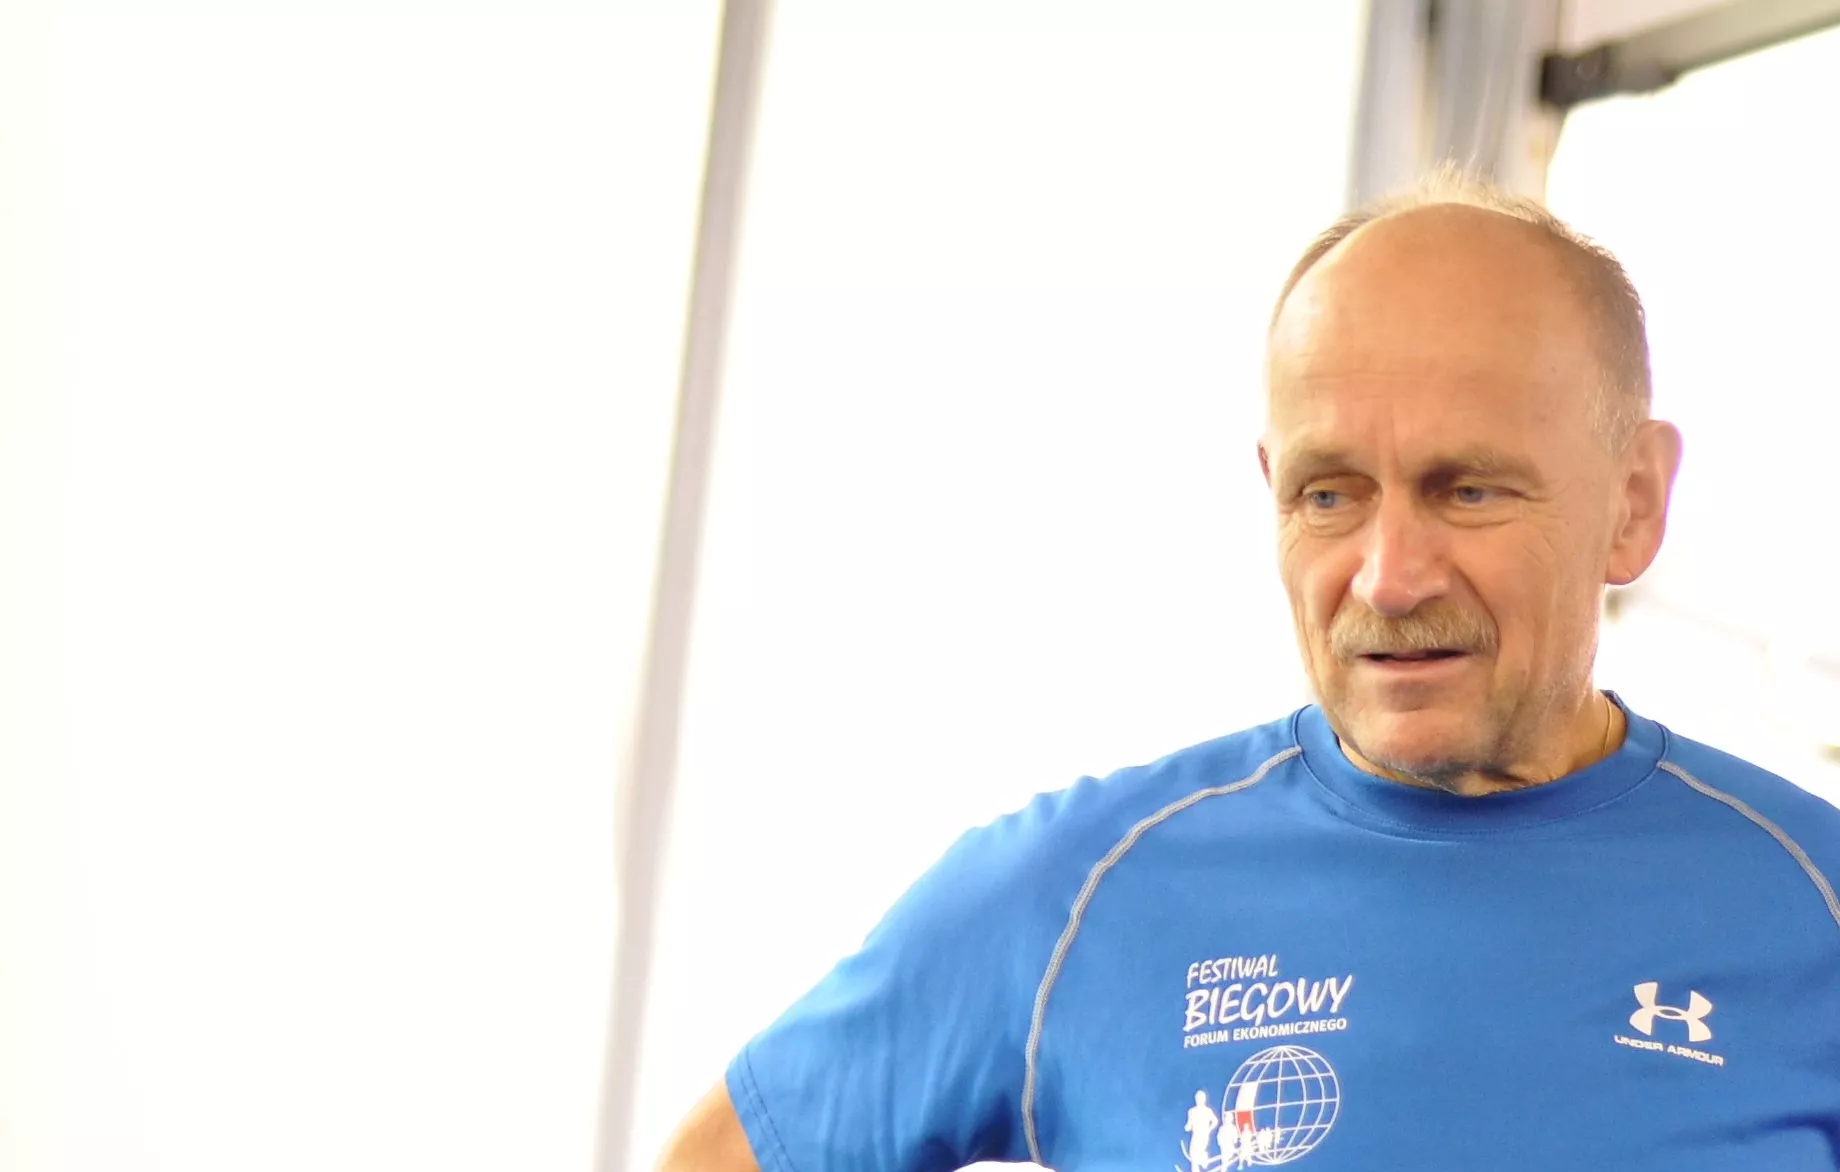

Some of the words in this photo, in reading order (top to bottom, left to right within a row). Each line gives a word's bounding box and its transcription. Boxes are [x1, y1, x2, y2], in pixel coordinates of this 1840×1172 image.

[1187, 955, 1278, 988] FESTIWAL
[1183, 975, 1352, 1031] BIEGOWY
[1184, 1030, 1228, 1048] FORUM
[1233, 1018, 1347, 1041] EKONOMICZNEGO
[1614, 1035, 1663, 1051] UNDER
[1667, 1045, 1724, 1066] ARMOUR
